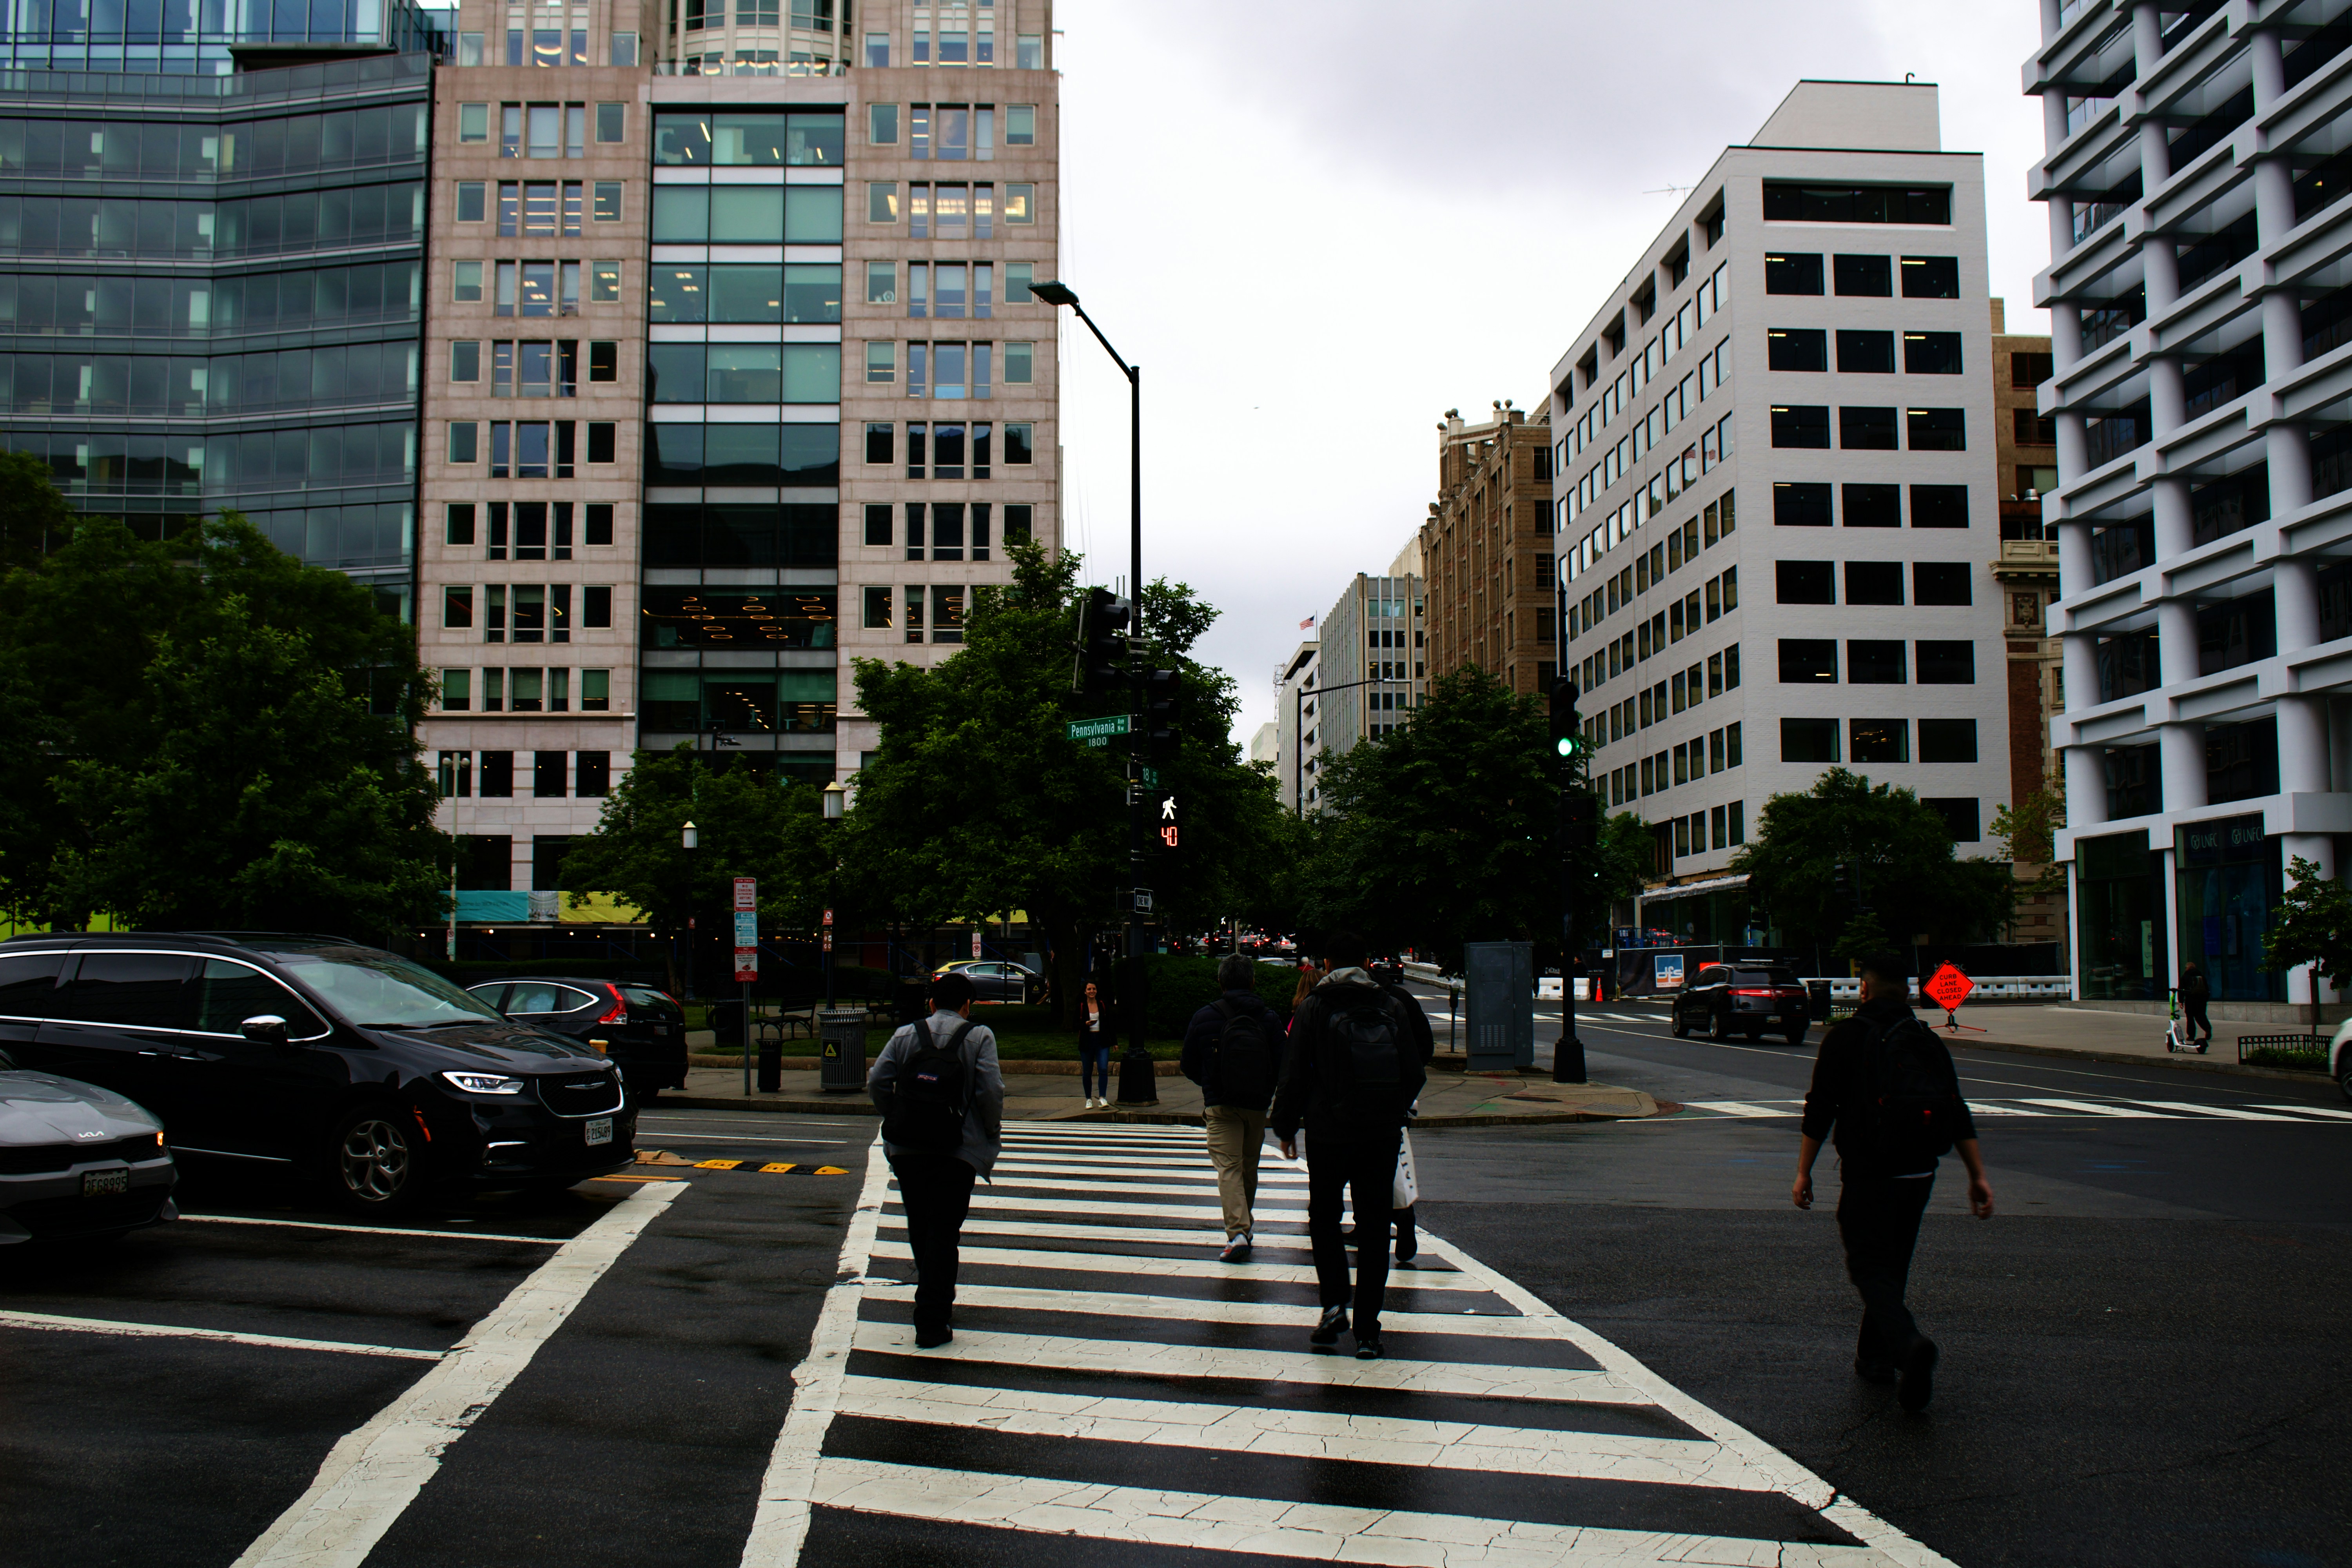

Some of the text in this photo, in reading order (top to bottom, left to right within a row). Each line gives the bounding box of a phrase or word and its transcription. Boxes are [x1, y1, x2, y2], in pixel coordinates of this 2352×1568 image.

[1071, 720, 1115, 737] Pennsylvania
[1088, 737, 1107, 747] 1800
[1143, 768, 1149, 781] 18
[1161, 826, 1177, 846] 40
[1657, 966, 1683, 983] dfs
[85, 1176, 127, 1196] 3FG8995
